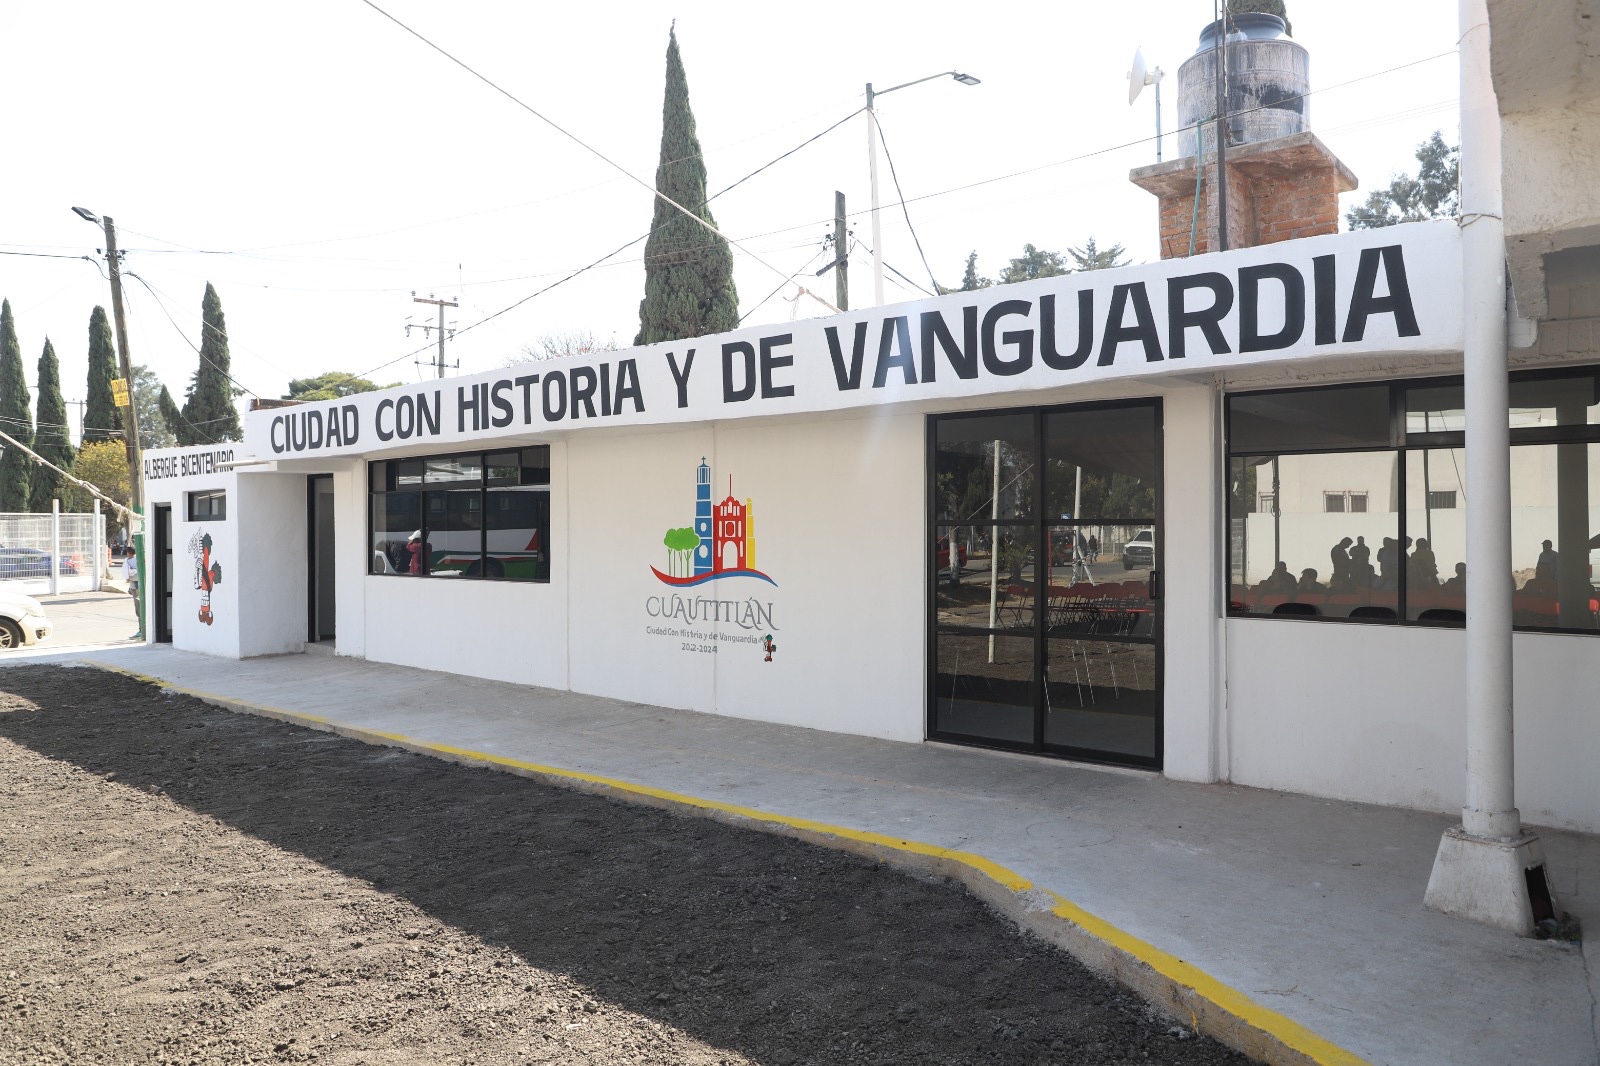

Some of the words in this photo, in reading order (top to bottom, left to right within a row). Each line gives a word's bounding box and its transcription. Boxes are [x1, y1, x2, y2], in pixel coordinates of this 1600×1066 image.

[270, 404, 359, 454] CIUDAD
[375, 390, 441, 439] CON
[457, 358, 645, 432] HISTORIA
[665, 348, 696, 409] Y
[721, 333, 795, 403] DE
[824, 244, 1421, 391] VANGUARDIA
[144, 456, 178, 480] ALBERGUE
[181, 449, 234, 477] BICENTENARIO
[646, 593, 780, 631] CUAUTITLÁN
[646, 625, 667, 636] Ciudad
[667, 627, 679, 637] Con
[703, 632, 708, 641] y
[708, 631, 718, 640] de
[719, 632, 758, 645] Vanguardia
